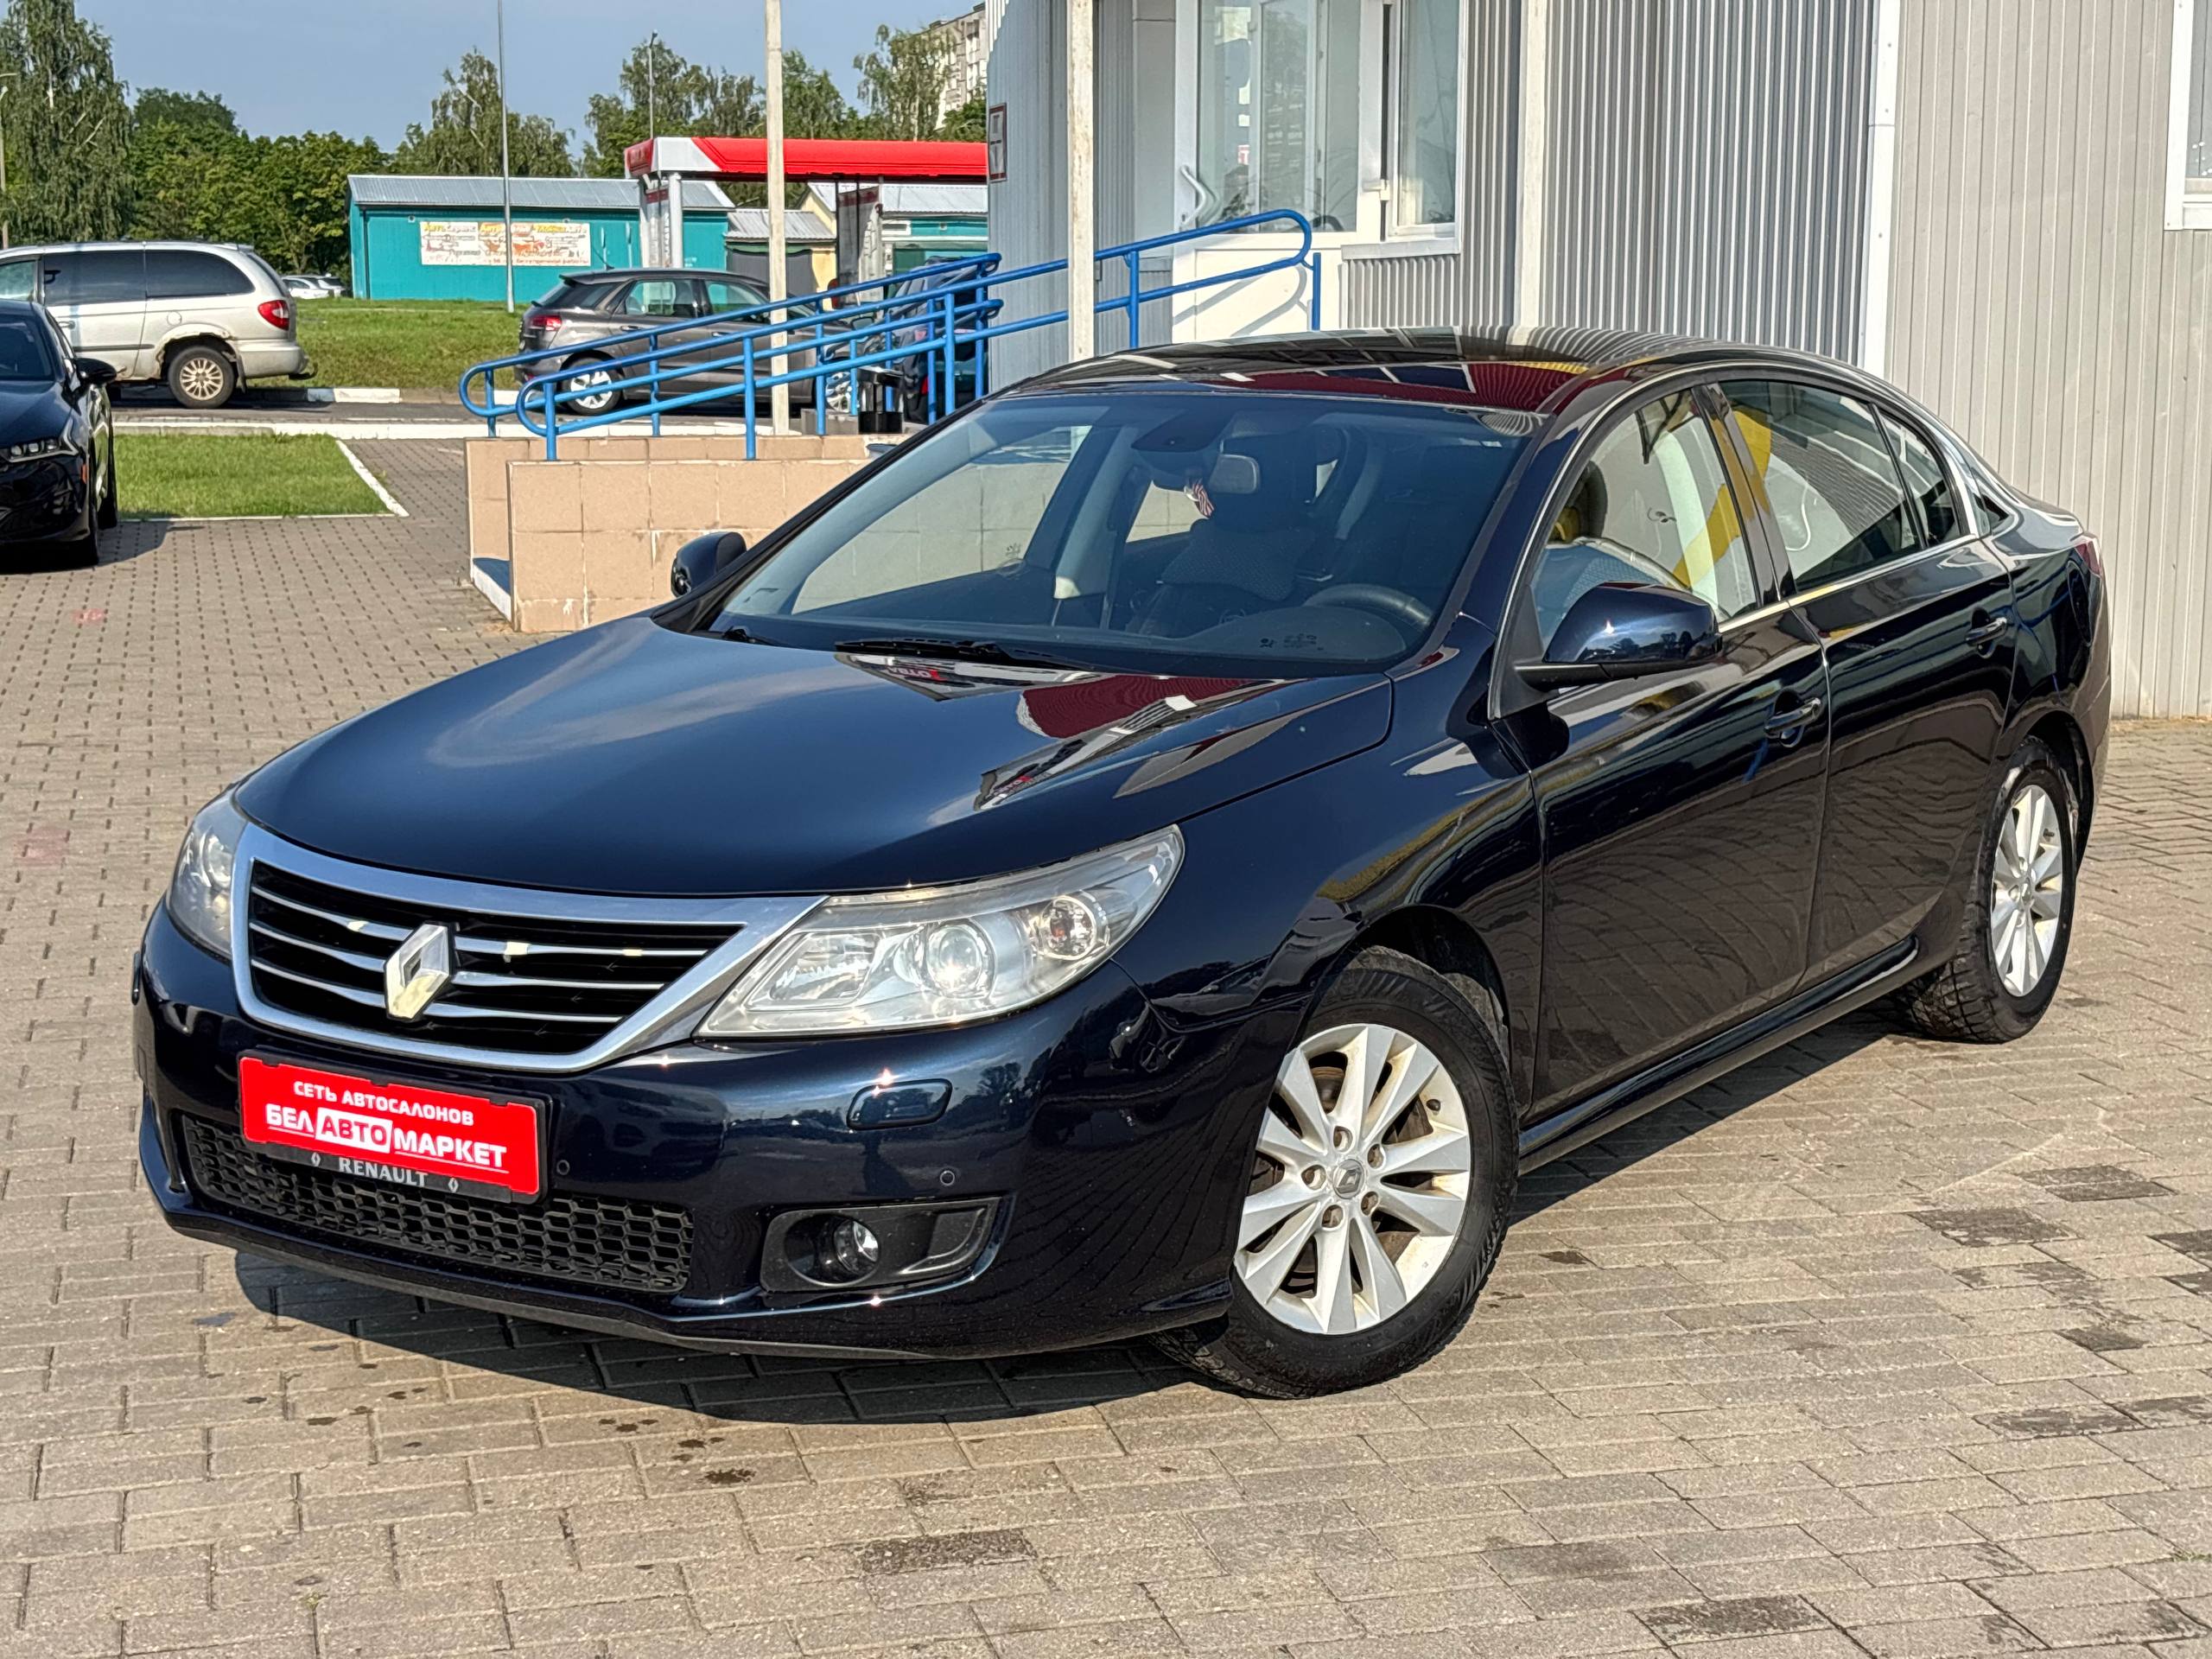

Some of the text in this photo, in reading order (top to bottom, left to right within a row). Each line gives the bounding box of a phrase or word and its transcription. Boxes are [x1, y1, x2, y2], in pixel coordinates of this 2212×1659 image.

[293, 1080, 474, 1127] СЕТЬ АВТОСАЛОНОВ
[338, 1157, 429, 1188] RENAULT
